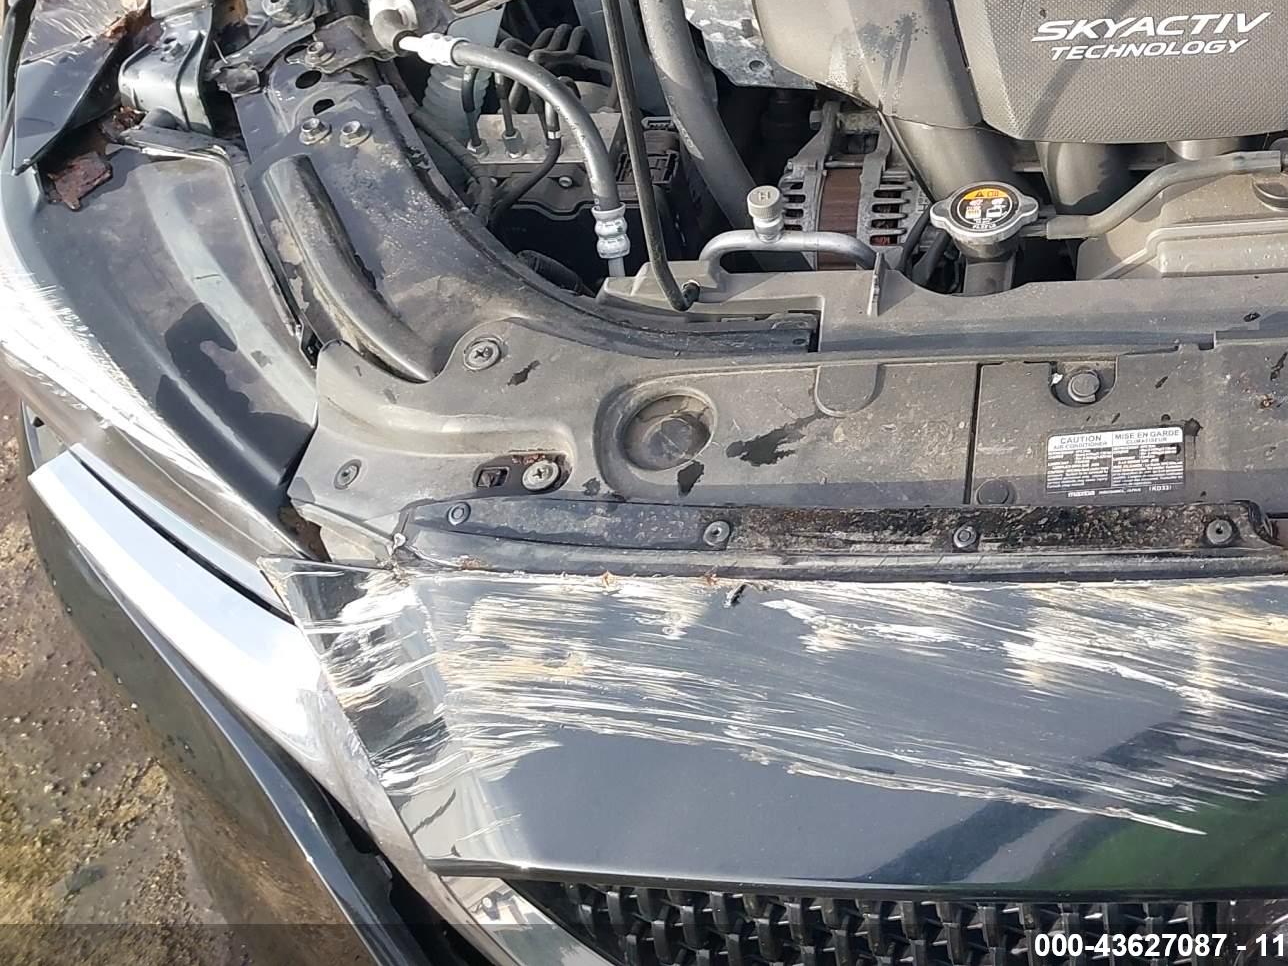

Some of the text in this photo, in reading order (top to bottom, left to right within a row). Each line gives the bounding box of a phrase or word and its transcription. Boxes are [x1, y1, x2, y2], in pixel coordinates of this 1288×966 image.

[1031, 11, 1273, 42] SKYACTIV
[1050, 39, 1249, 61] TECHNOLOGY
[1060, 434, 1102, 444] CAUTION
[1114, 429, 1180, 440] MISE EN GARDE
[1065, 441, 1107, 450] CONDITIONER
